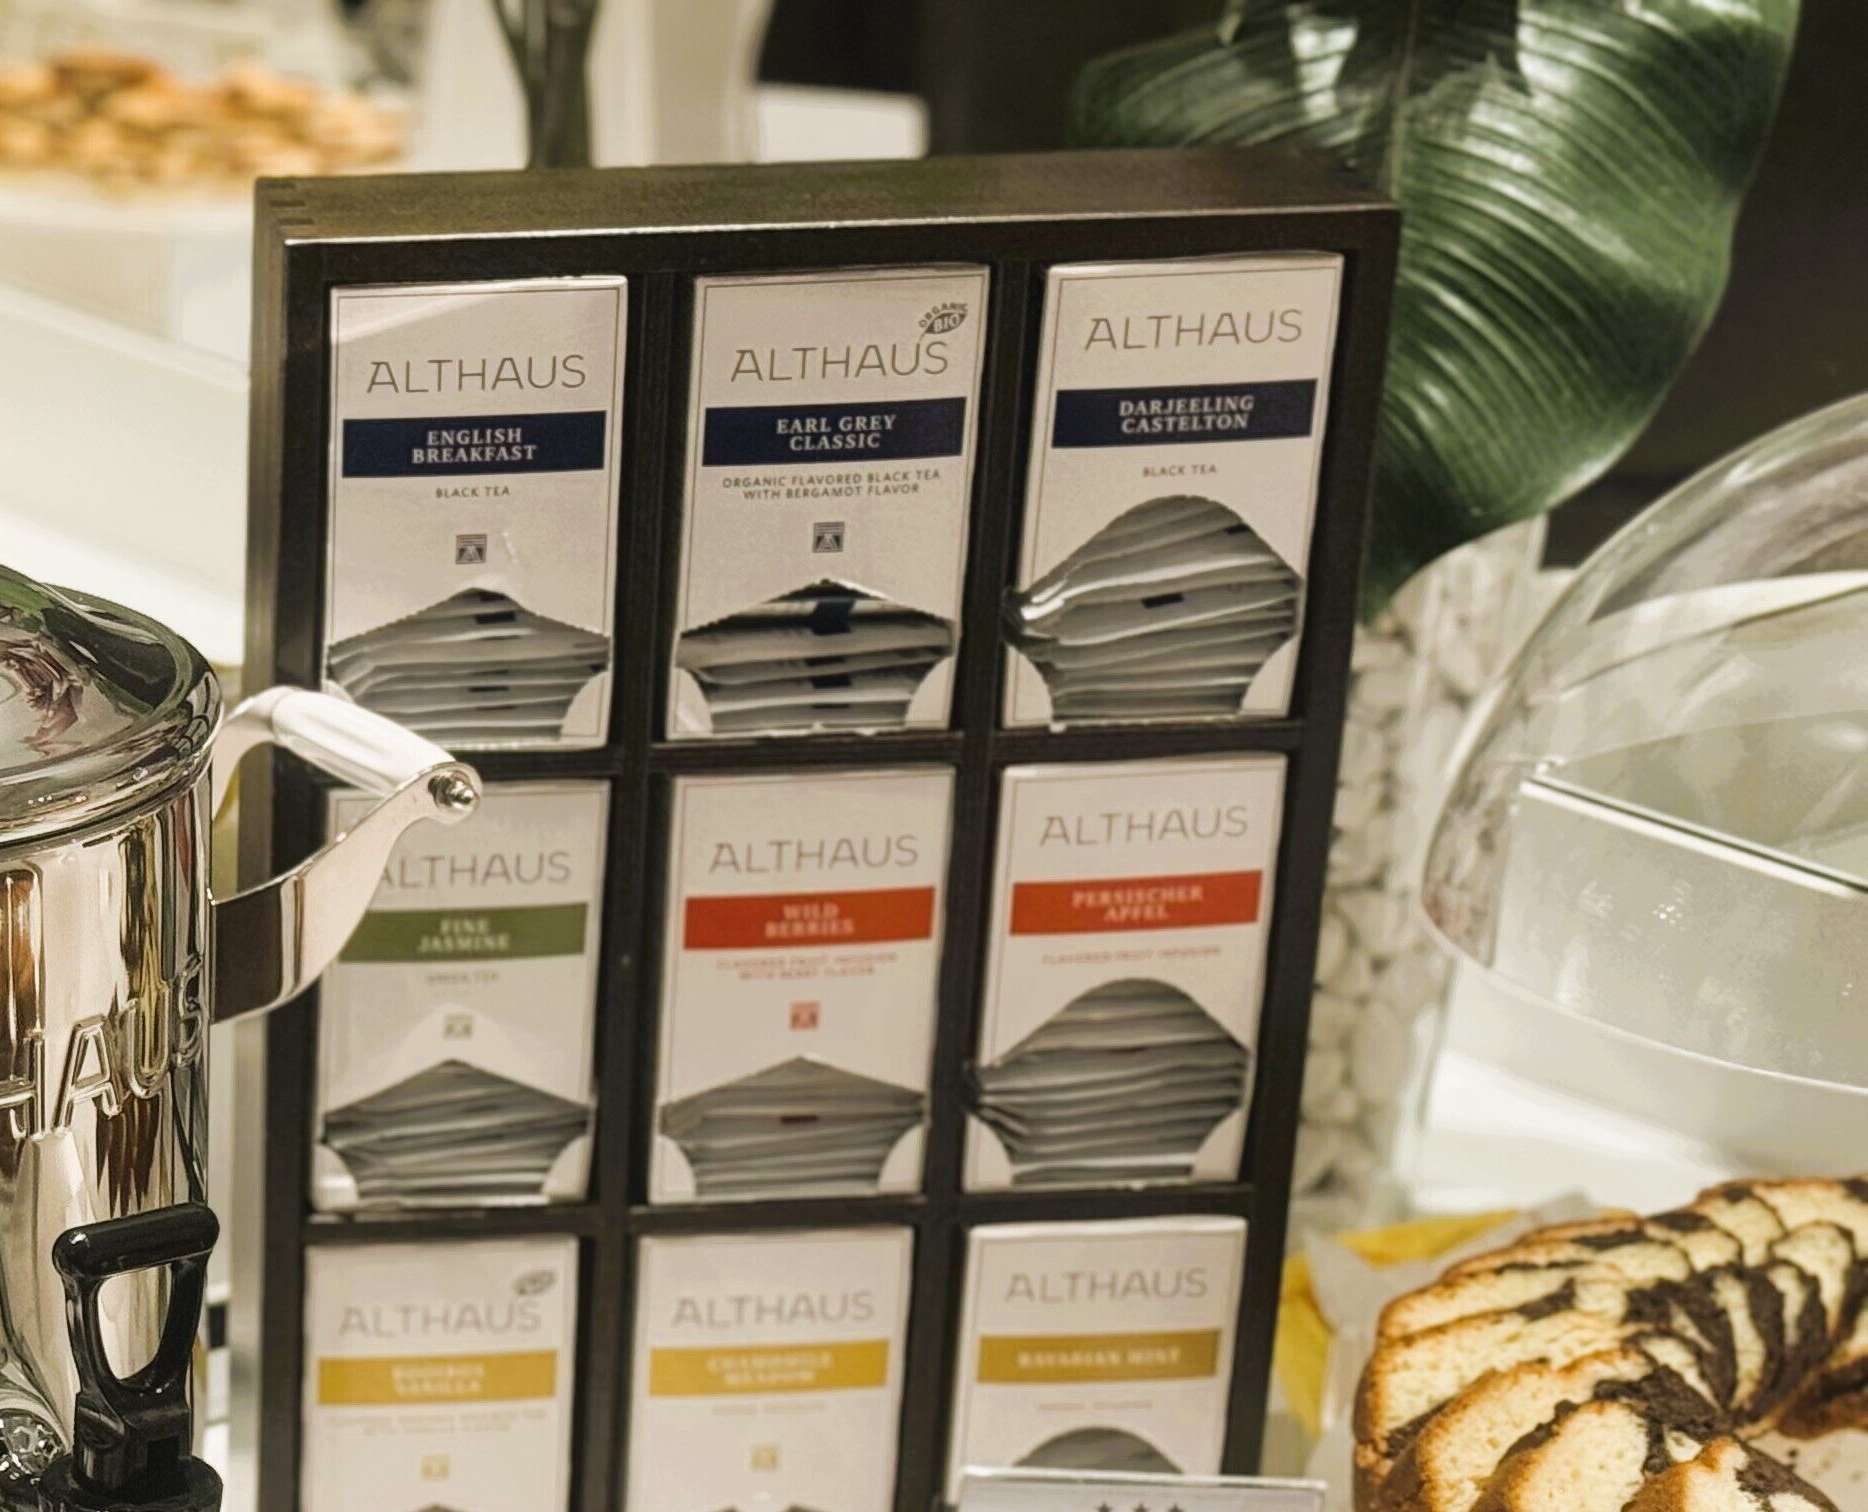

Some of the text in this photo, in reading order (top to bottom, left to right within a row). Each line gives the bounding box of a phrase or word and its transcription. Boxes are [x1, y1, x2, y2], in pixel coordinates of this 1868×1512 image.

[933, 313, 960, 332] BIO
[1085, 309, 1303, 351] ALTHAUS
[730, 341, 948, 382] ALTHAUS
[366, 354, 586, 394] ALTHAUS
[1119, 395, 1255, 417] DARJEELING
[776, 414, 897, 434] EARL GREY
[1121, 413, 1249, 433] CASTELTON
[427, 427, 522, 446] ENGLISH
[790, 432, 881, 451] CLASSIC
[412, 445, 537, 464] BREAKFAST
[722, 468, 940, 489] ORGANIC FLAVORED BLACK TEA
[1143, 464, 1217, 478] BLACK TEA
[435, 486, 510, 499] BLACK TEA
[743, 482, 919, 500] WITH BERGAMOT FLAVOR
[1039, 805, 1249, 847] ALTHAUS
[709, 834, 919, 874] ALTHAUS
[1005, 1267, 1208, 1304] ALTHAUS
[339, 1300, 542, 1338] ALTHAUS
[672, 1290, 874, 1330] ALTHAUS
